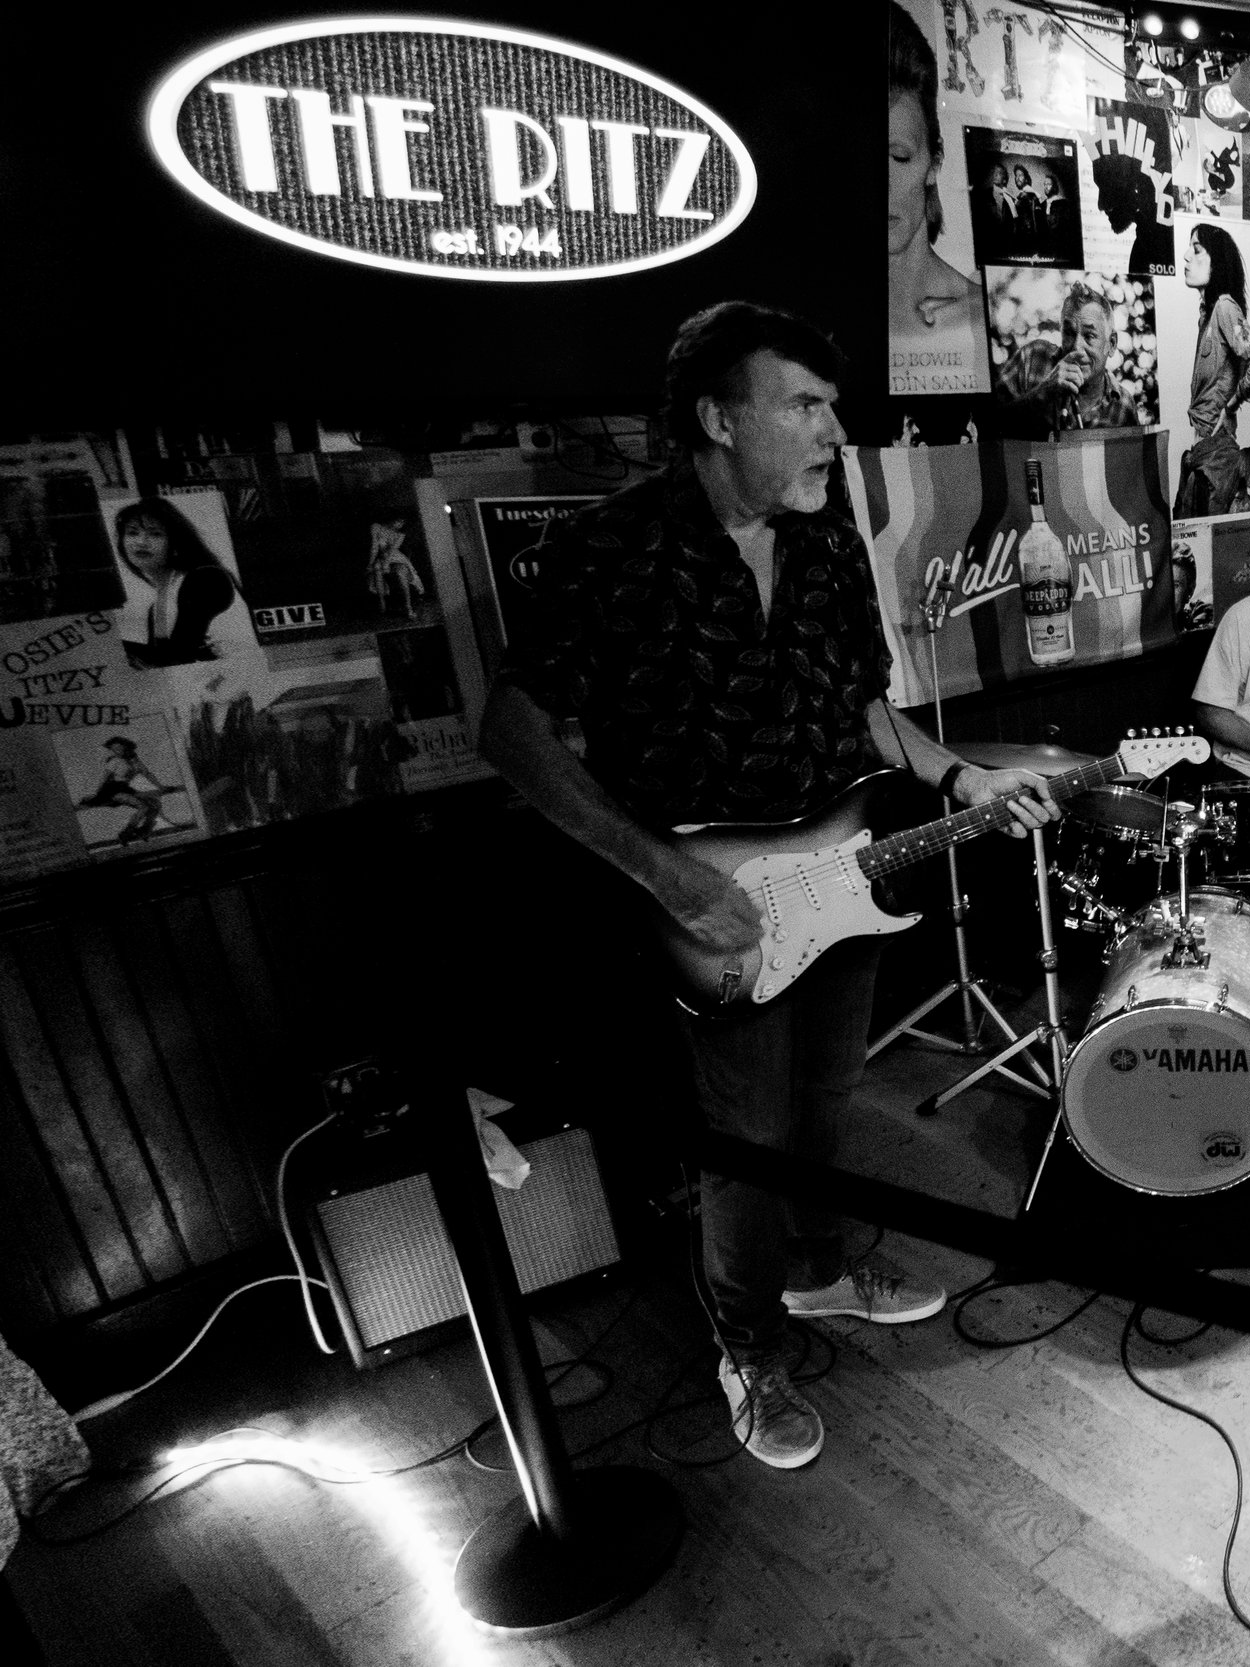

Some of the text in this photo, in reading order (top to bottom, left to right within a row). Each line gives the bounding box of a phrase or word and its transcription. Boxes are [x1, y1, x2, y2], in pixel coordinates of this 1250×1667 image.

[209, 81, 714, 221] THE RITZ
[431, 224, 562, 258] est. 1944
[1149, 264, 1176, 276] SOLO
[909, 352, 962, 367] BOWIE
[931, 374, 979, 391] SANE
[494, 506, 575, 522] Tuesda
[1067, 523, 1151, 556] MEANS
[1073, 550, 1154, 602] ALL!
[256, 605, 324, 628] GIVE
[1142, 1048, 1249, 1073] YAMAHA
